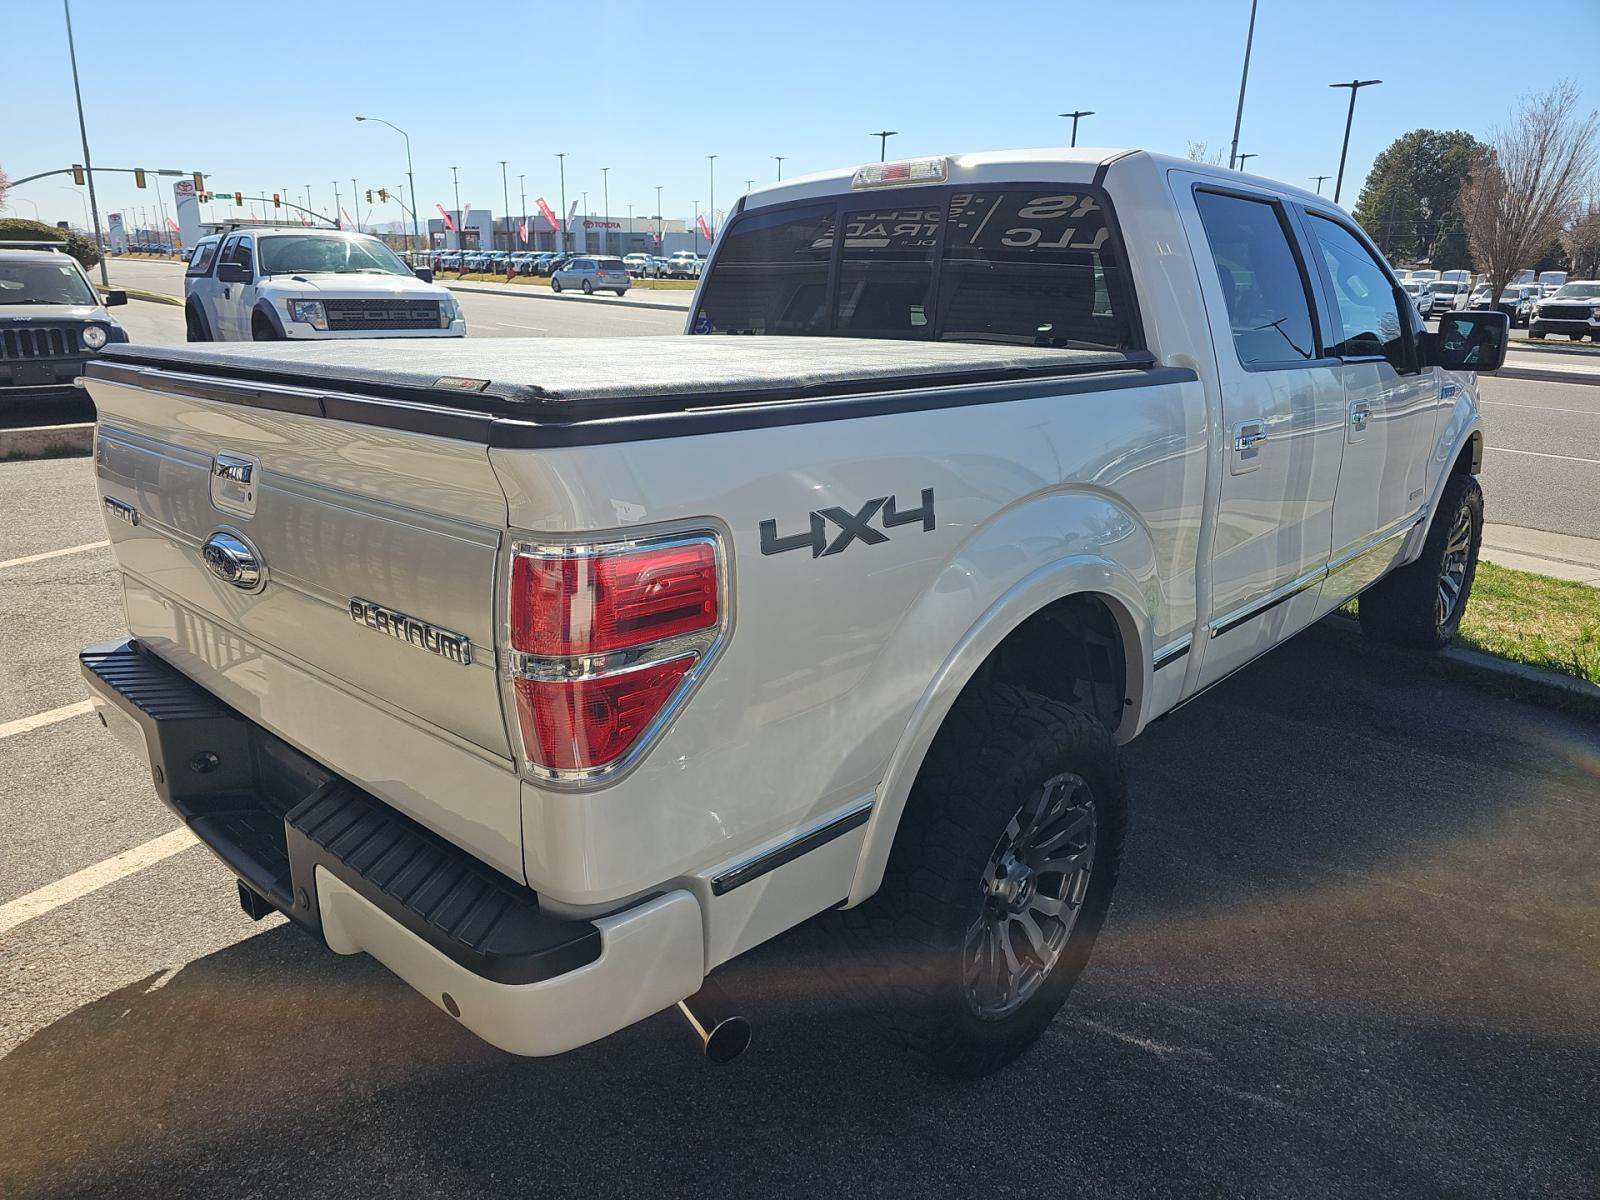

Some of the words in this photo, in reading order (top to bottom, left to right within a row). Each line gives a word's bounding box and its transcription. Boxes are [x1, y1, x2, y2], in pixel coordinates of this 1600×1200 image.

[594, 221, 621, 229] TOYOTA
[759, 487, 936, 559] 4X4
[348, 596, 471, 665] PLATINUM
